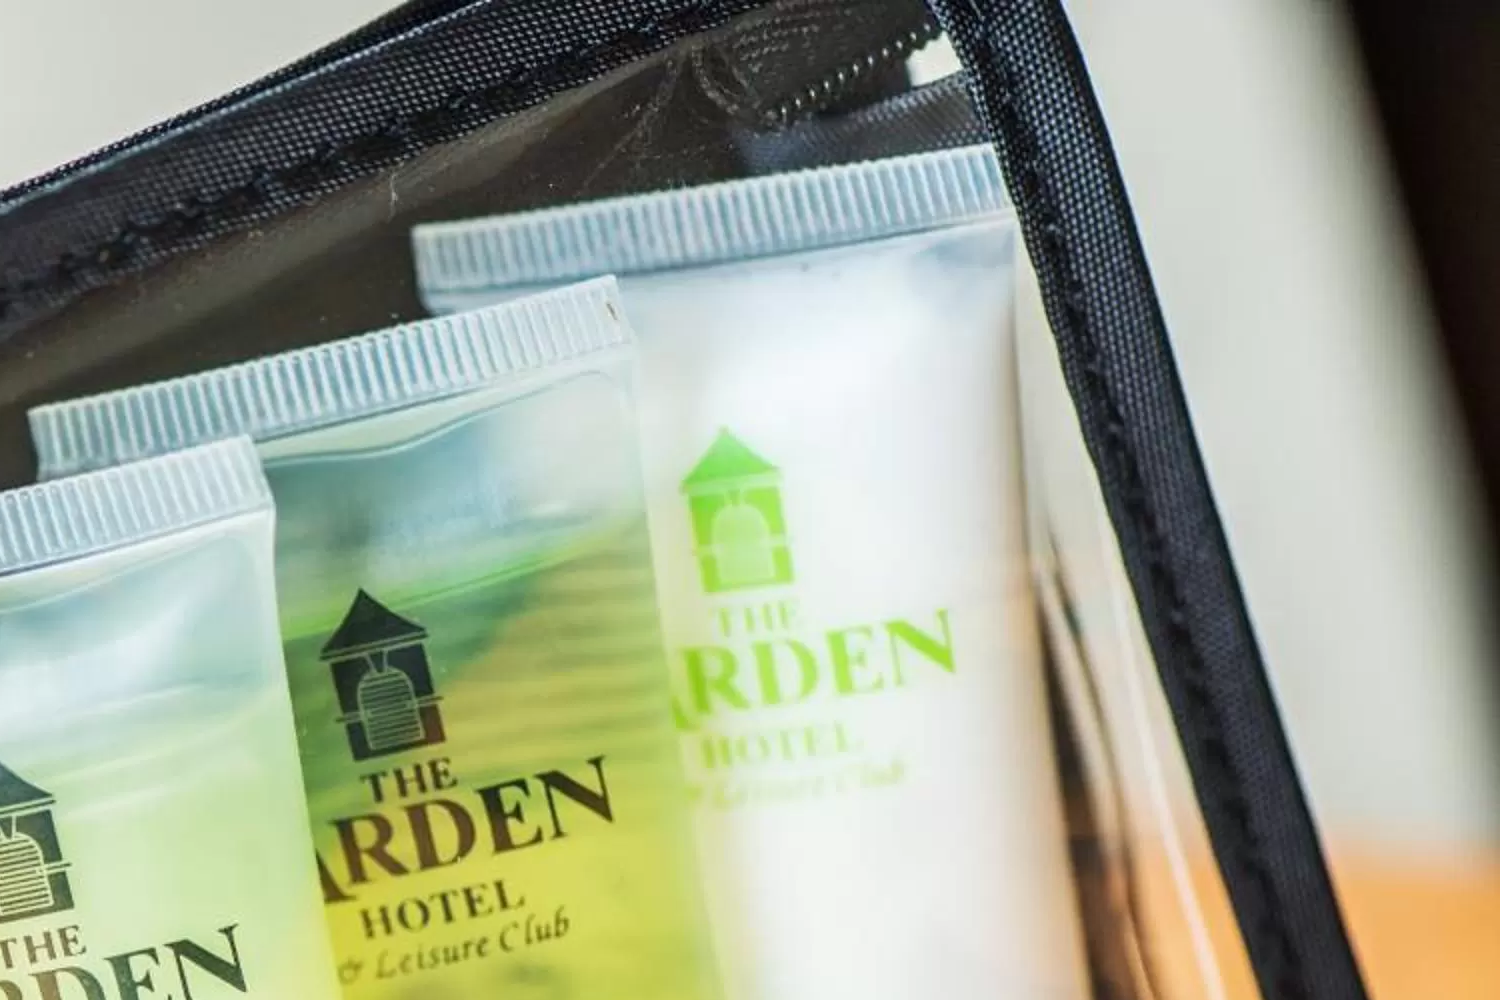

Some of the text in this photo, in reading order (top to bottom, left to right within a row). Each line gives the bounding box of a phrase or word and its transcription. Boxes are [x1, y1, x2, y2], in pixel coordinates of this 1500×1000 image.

[669, 607, 957, 732] RDEN
[360, 757, 459, 804] THE
[361, 879, 526, 940] HOTEL
[375, 934, 489, 981] Leisure
[499, 905, 570, 953] Club
